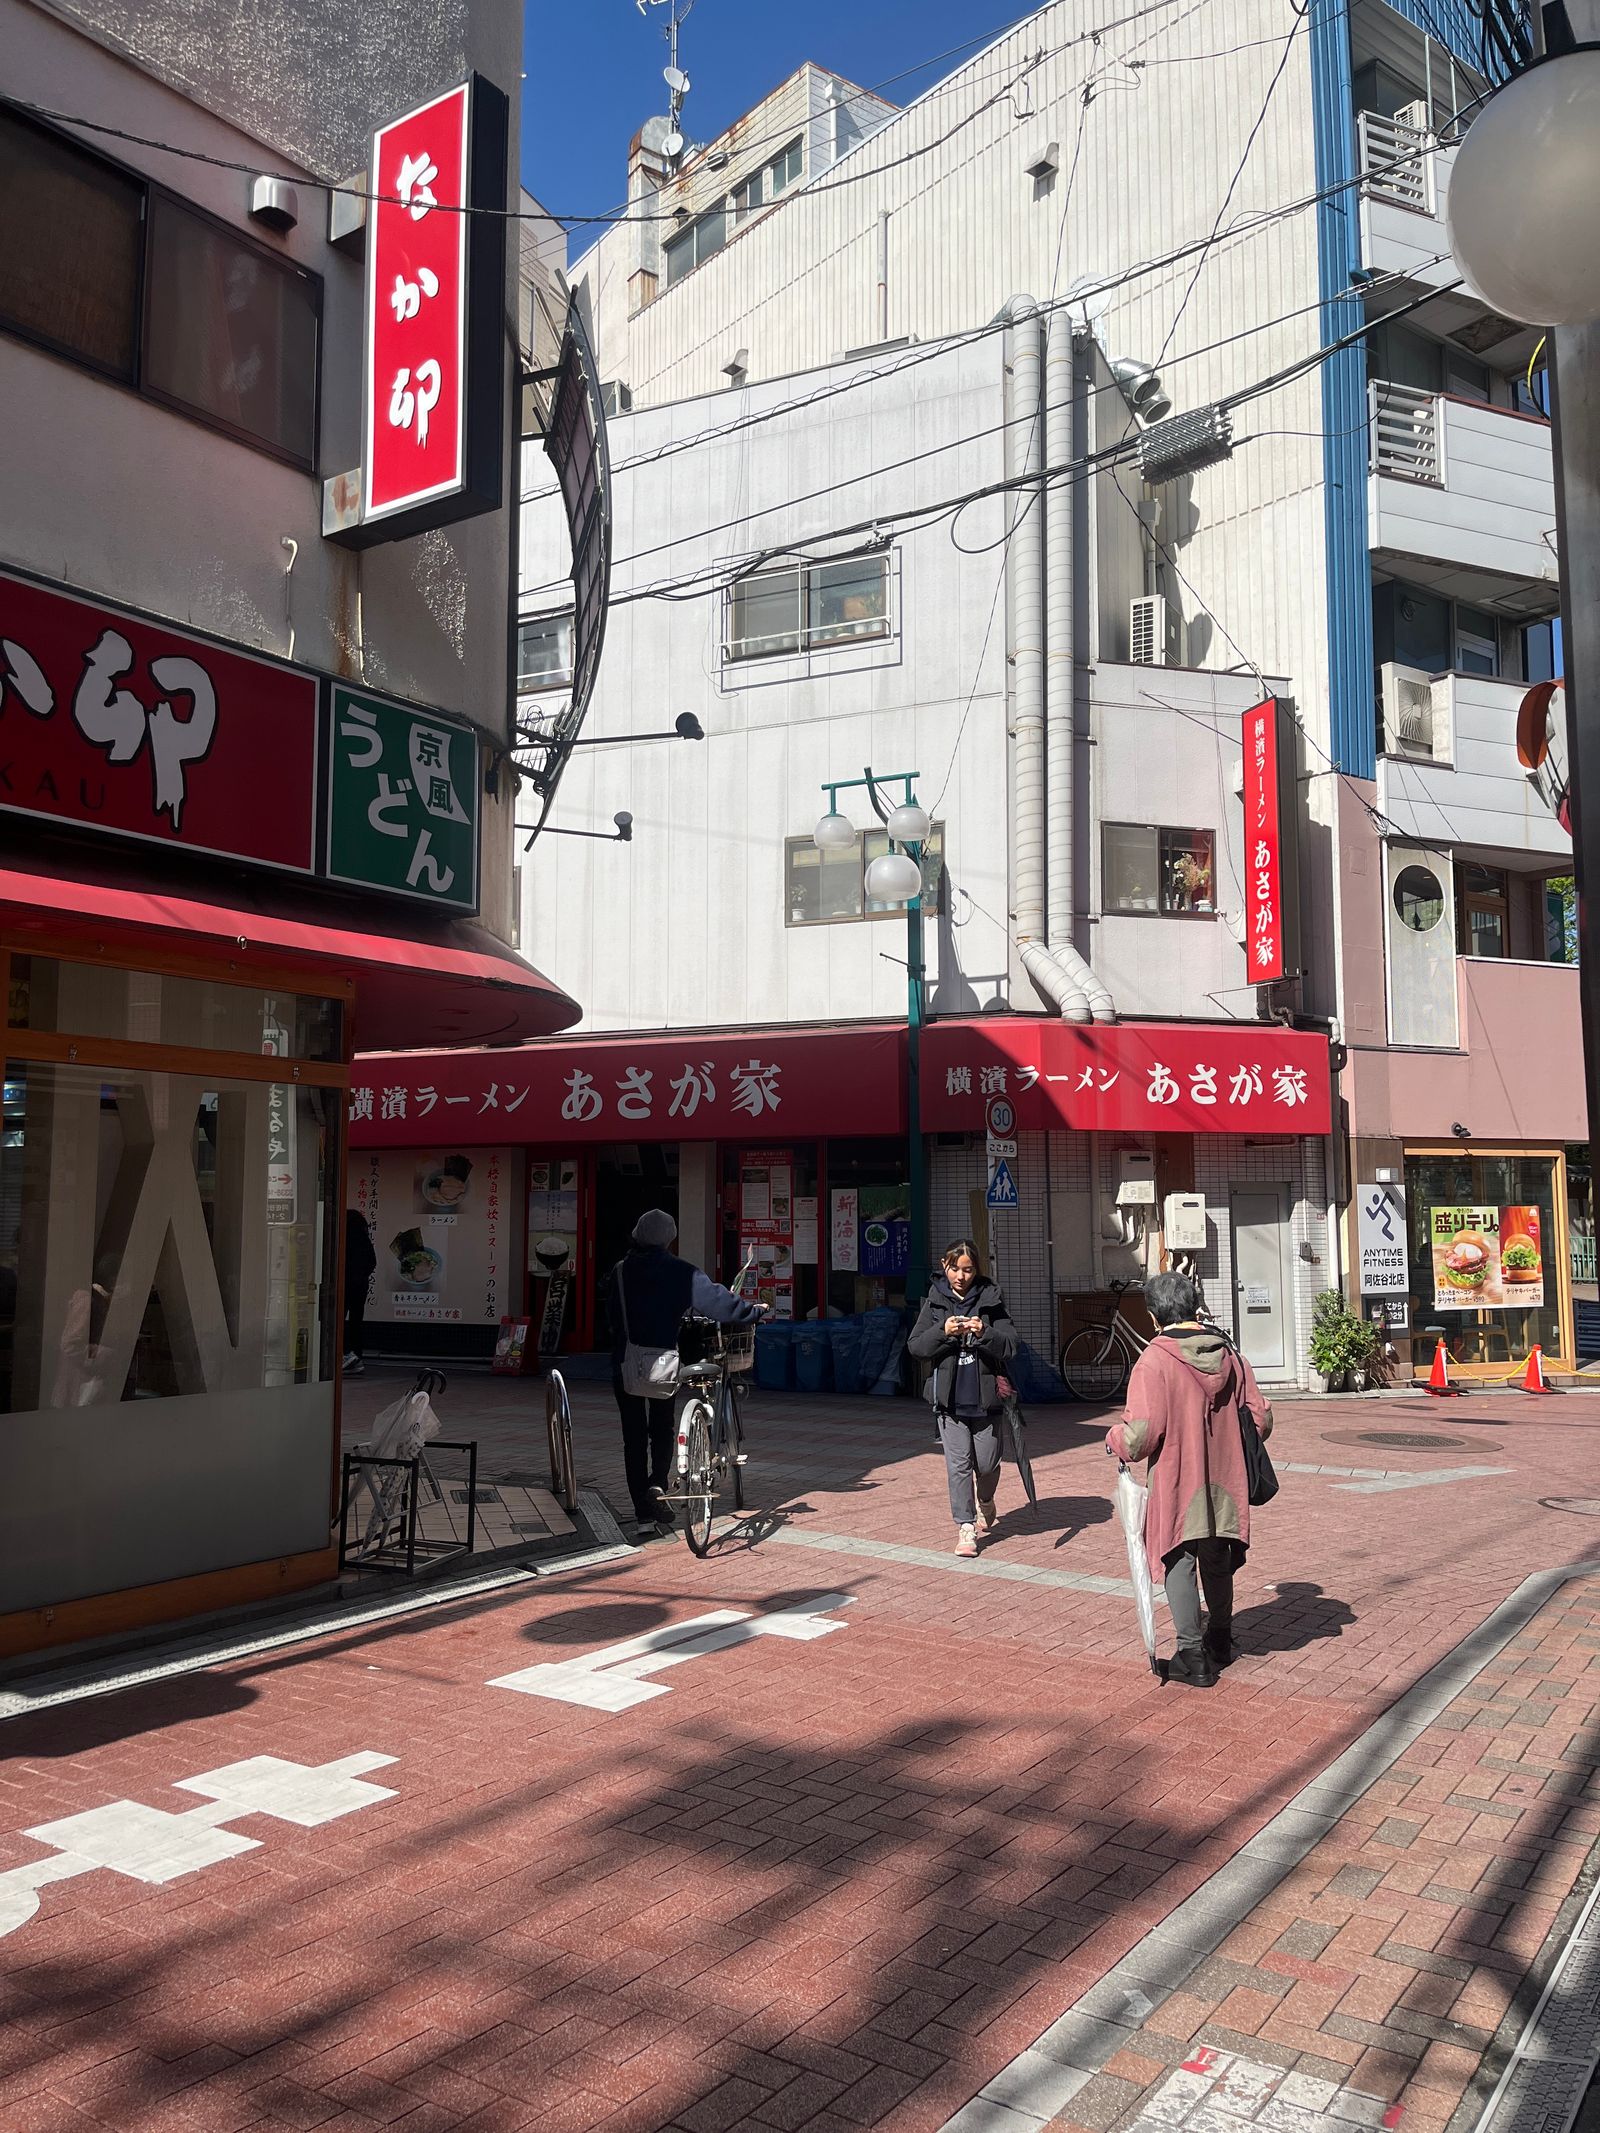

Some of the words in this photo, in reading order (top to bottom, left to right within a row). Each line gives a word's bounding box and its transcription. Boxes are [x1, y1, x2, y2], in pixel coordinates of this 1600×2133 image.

[388, 152, 442, 449] なか卯
[416, 732, 454, 814] 京風
[340, 702, 455, 892] うどん
[1254, 840, 1274, 968] あさが家
[561, 1059, 782, 1121] あさが家
[944, 1065, 1120, 1096] 横濱ラーメン
[1146, 1062, 1309, 1108] あさが家
[993, 1107, 1010, 1126] 30
[989, 1143, 1015, 1153] ここから
[1363, 1249, 1403, 1257] ANYTIME
[1363, 1258, 1404, 1267] FITNESS
[1364, 1274, 1405, 1287] 阿佐谷北店
[1385, 1302, 1403, 1311] こから
